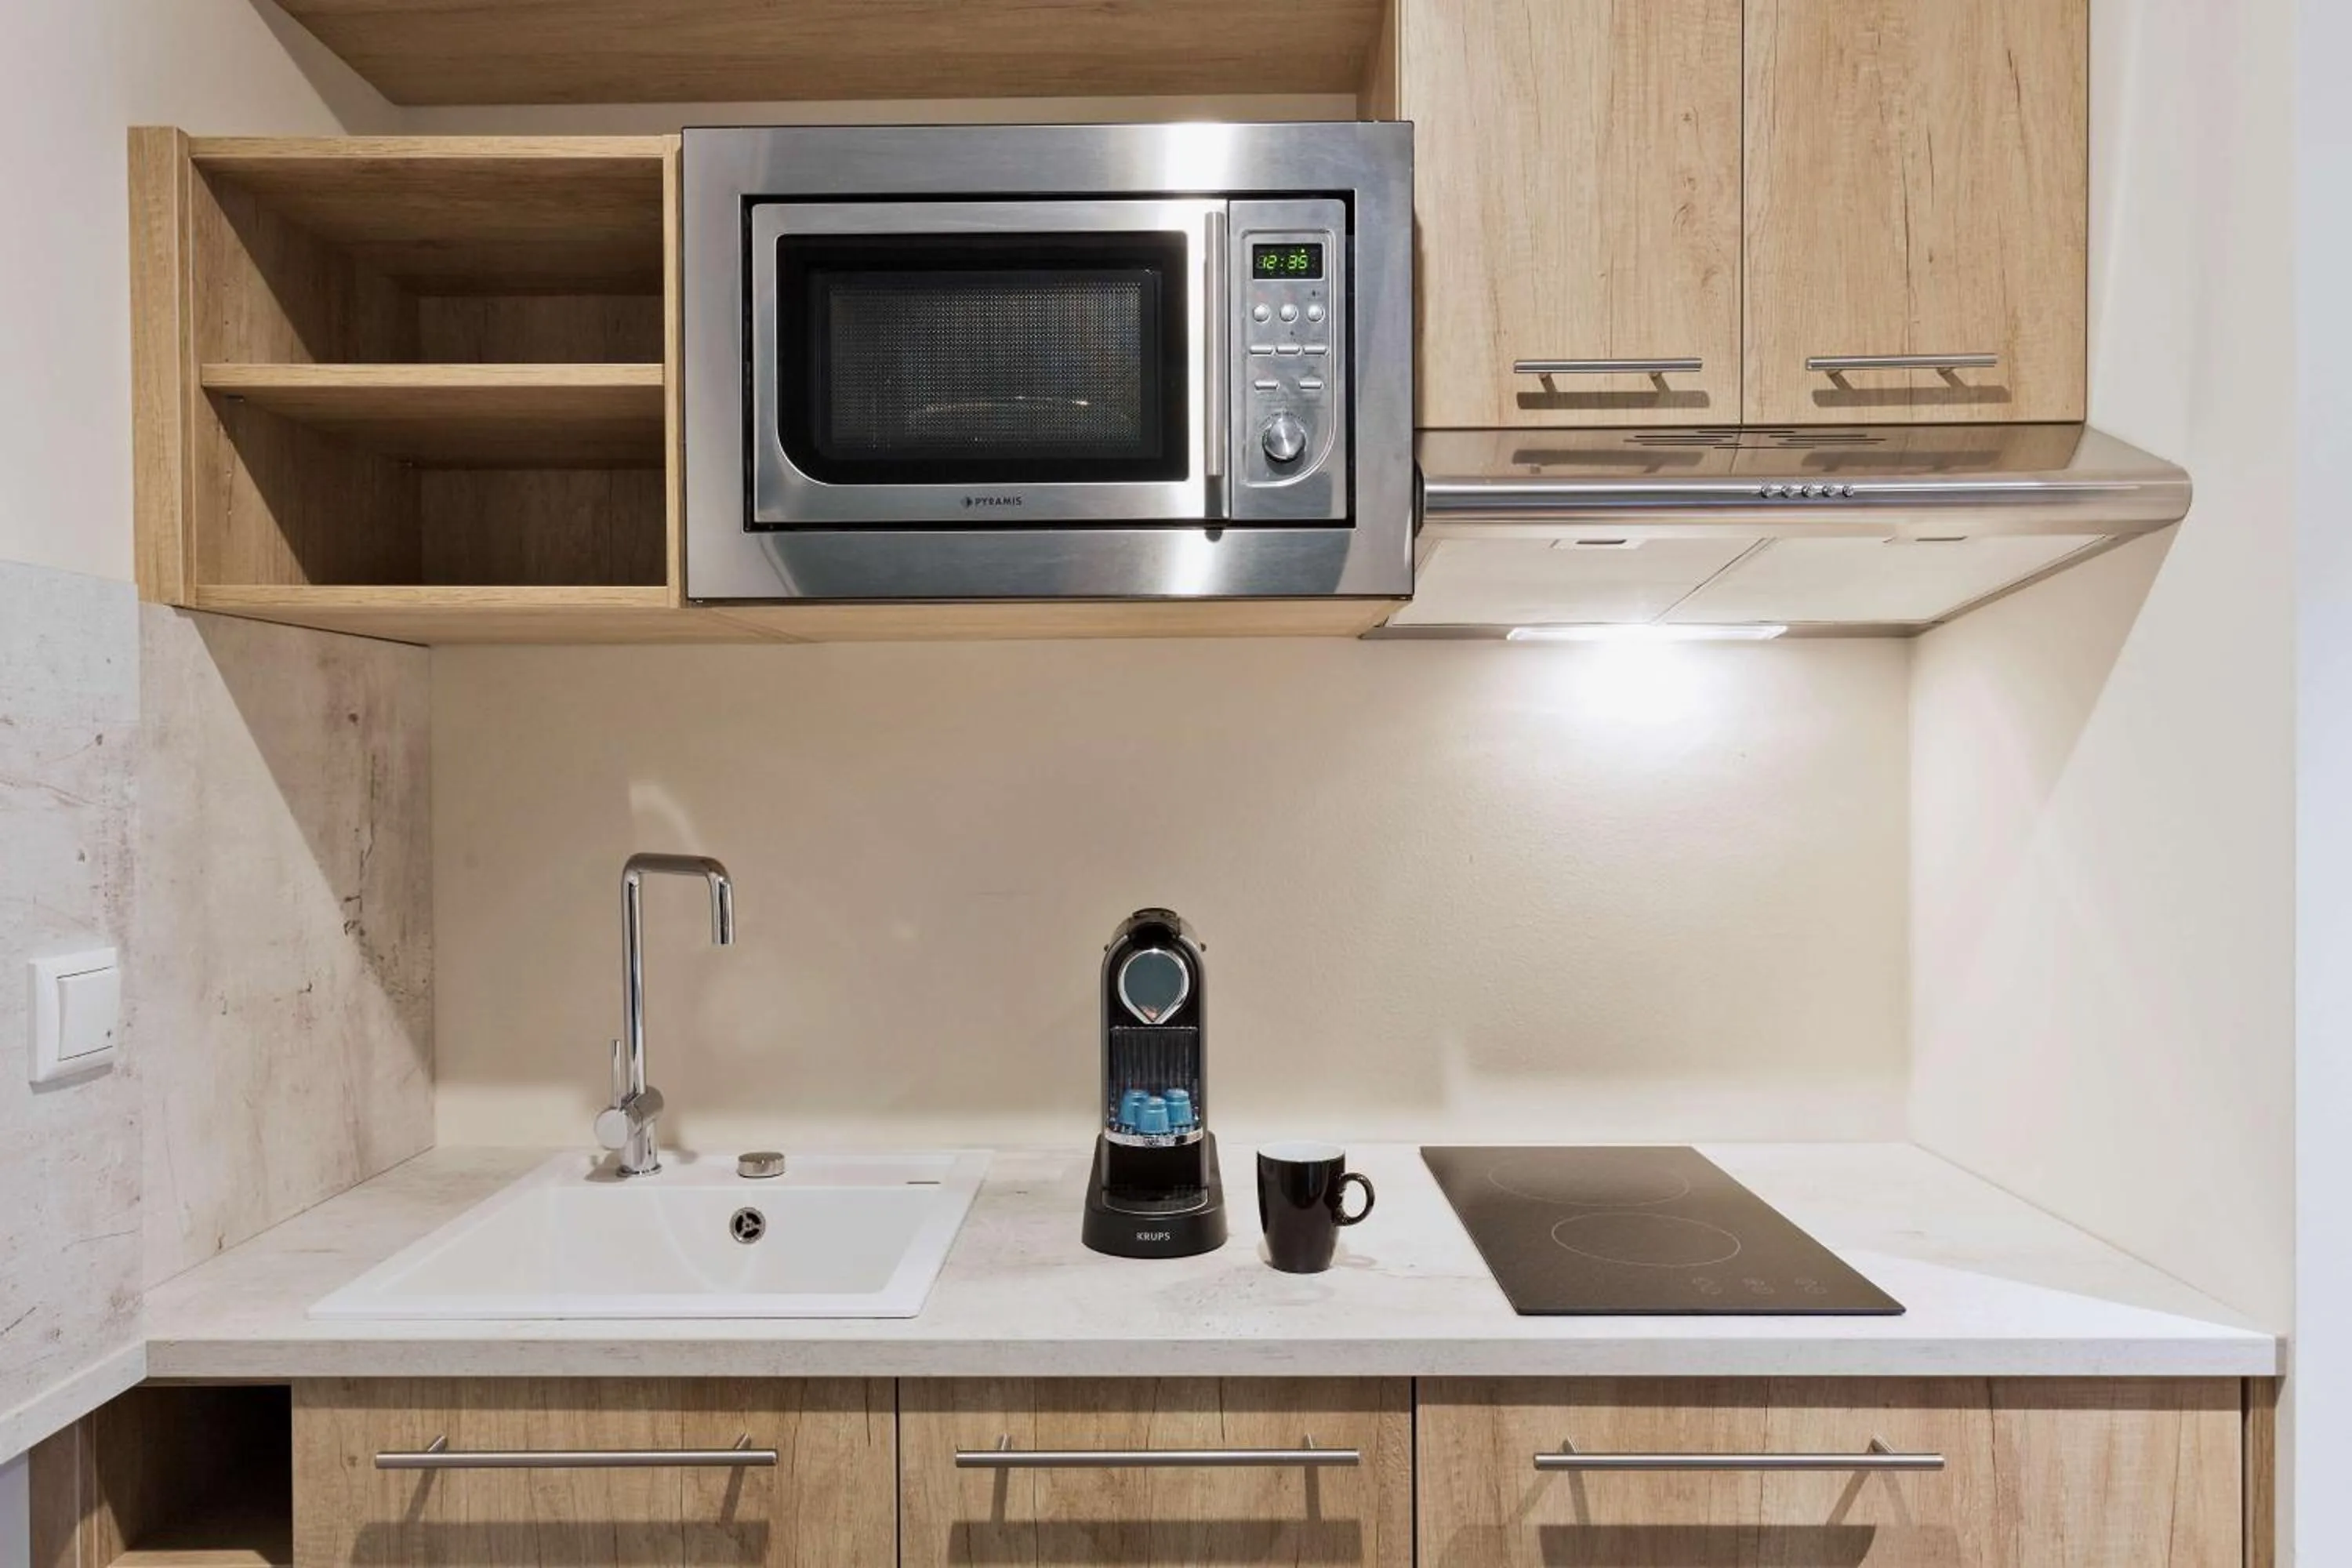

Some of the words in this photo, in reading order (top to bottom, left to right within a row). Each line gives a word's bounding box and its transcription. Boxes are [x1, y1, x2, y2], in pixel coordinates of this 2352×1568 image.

[1263, 255, 1308, 269] 12:35
[975, 496, 1022, 506] PYRAMIS
[1136, 1232, 1171, 1241] KRUPS
